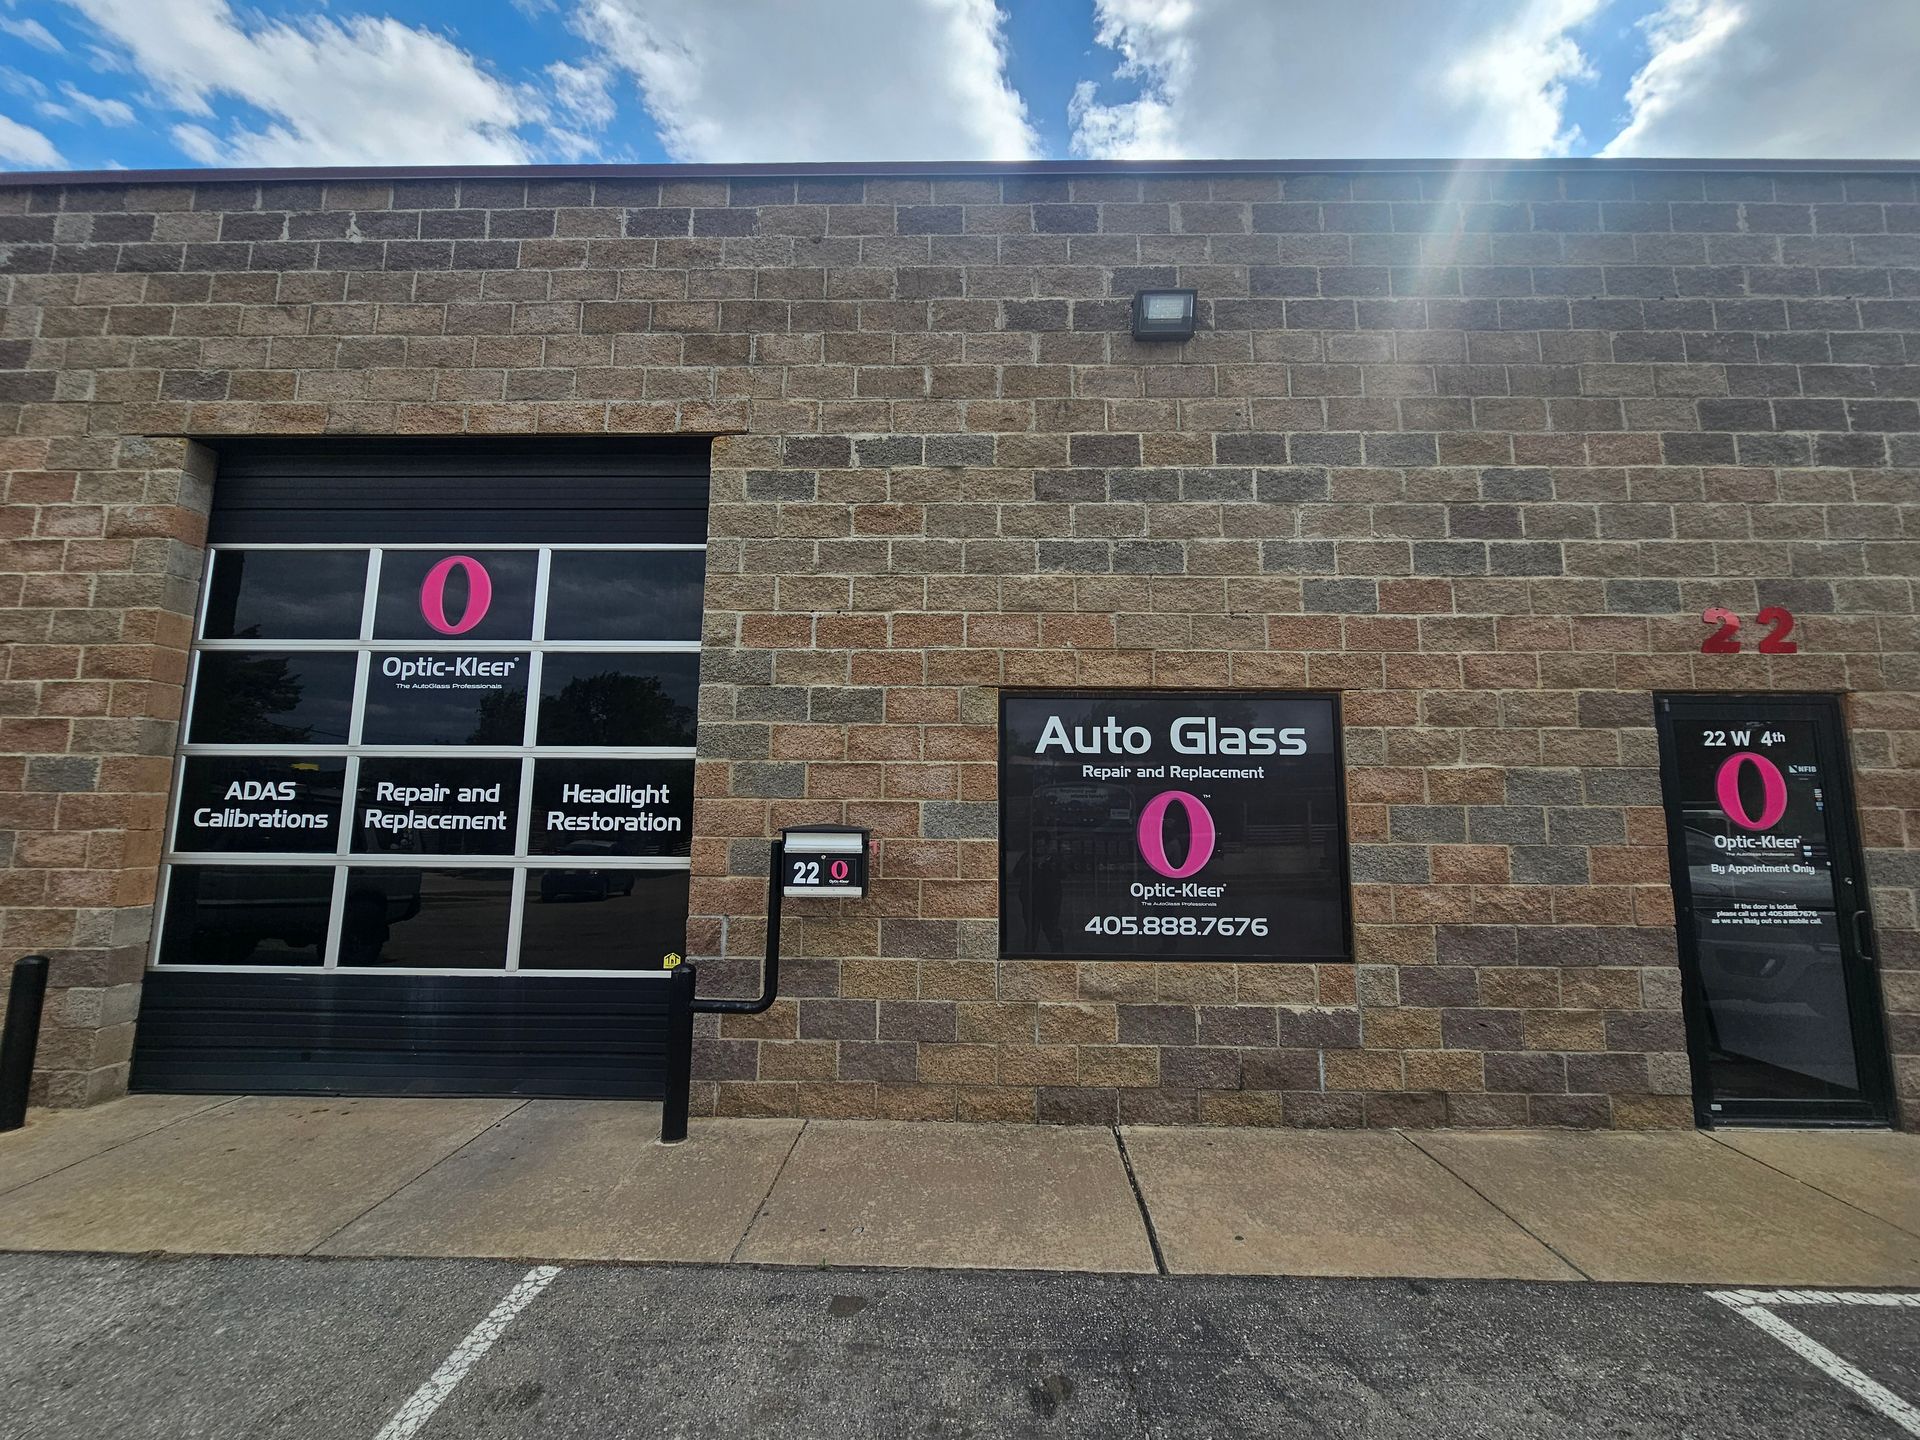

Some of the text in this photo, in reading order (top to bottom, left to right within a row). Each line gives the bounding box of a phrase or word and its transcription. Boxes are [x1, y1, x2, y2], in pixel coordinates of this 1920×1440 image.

[1701, 606, 1799, 654] 22
[1035, 716, 1306, 755] Auto Glass
[1704, 731, 1785, 746] 22 W 4th
[1083, 765, 1264, 781] Repair and Replacement
[224, 782, 296, 800] ADAS
[377, 782, 500, 806] Repair and
[563, 784, 669, 808] Headlight
[194, 808, 328, 828] Calibrations
[365, 809, 506, 833] Replacement
[547, 812, 680, 831] Restoration
[793, 862, 819, 884] 22
[1711, 864, 1815, 875] By Appointment Only
[1085, 916, 1268, 936] 405.888.7676
